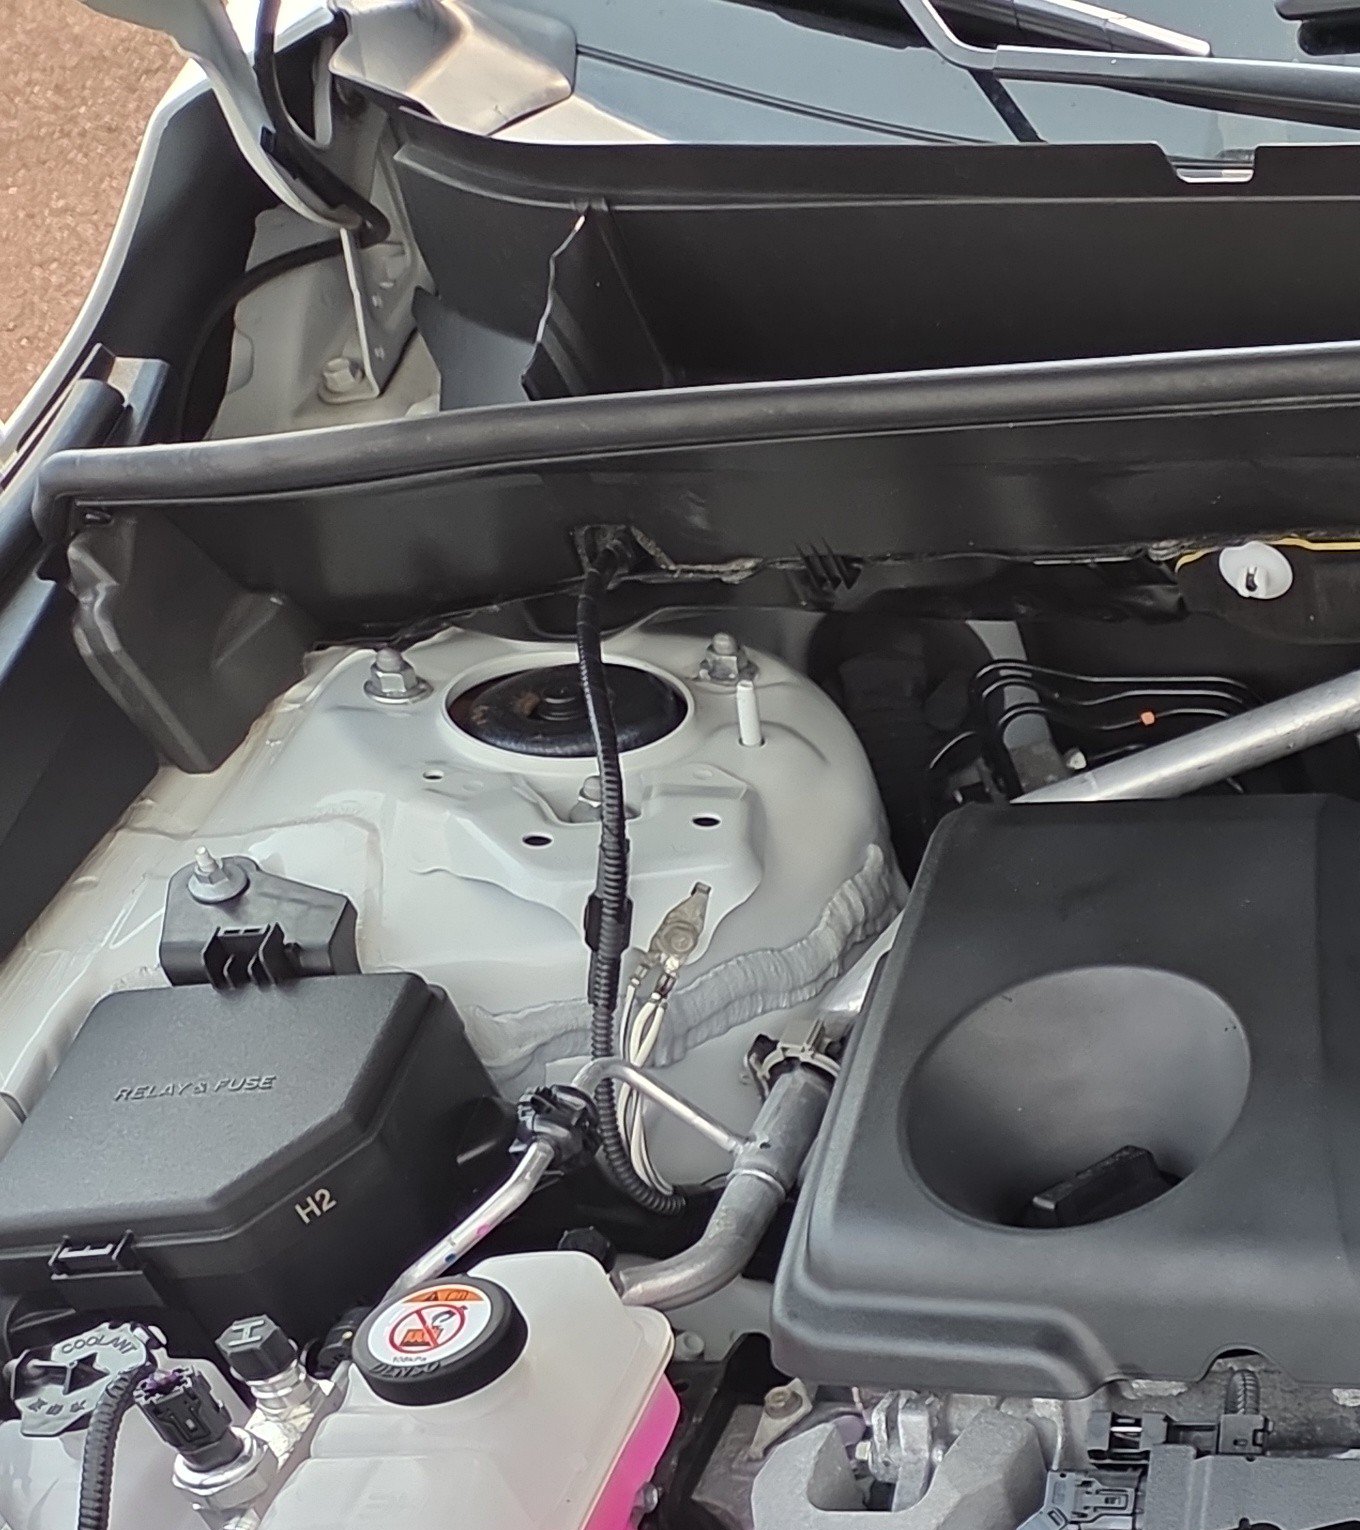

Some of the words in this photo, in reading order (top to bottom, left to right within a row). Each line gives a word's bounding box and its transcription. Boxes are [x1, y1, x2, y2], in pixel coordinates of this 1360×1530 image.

[114, 1081, 193, 1101] RELAY
[193, 1081, 208, 1095] &
[214, 1075, 277, 1094] FUSE
[294, 1188, 338, 1224] H2
[61, 1335, 138, 1356] COOLANT
[369, 1360, 441, 1379] DENSO
